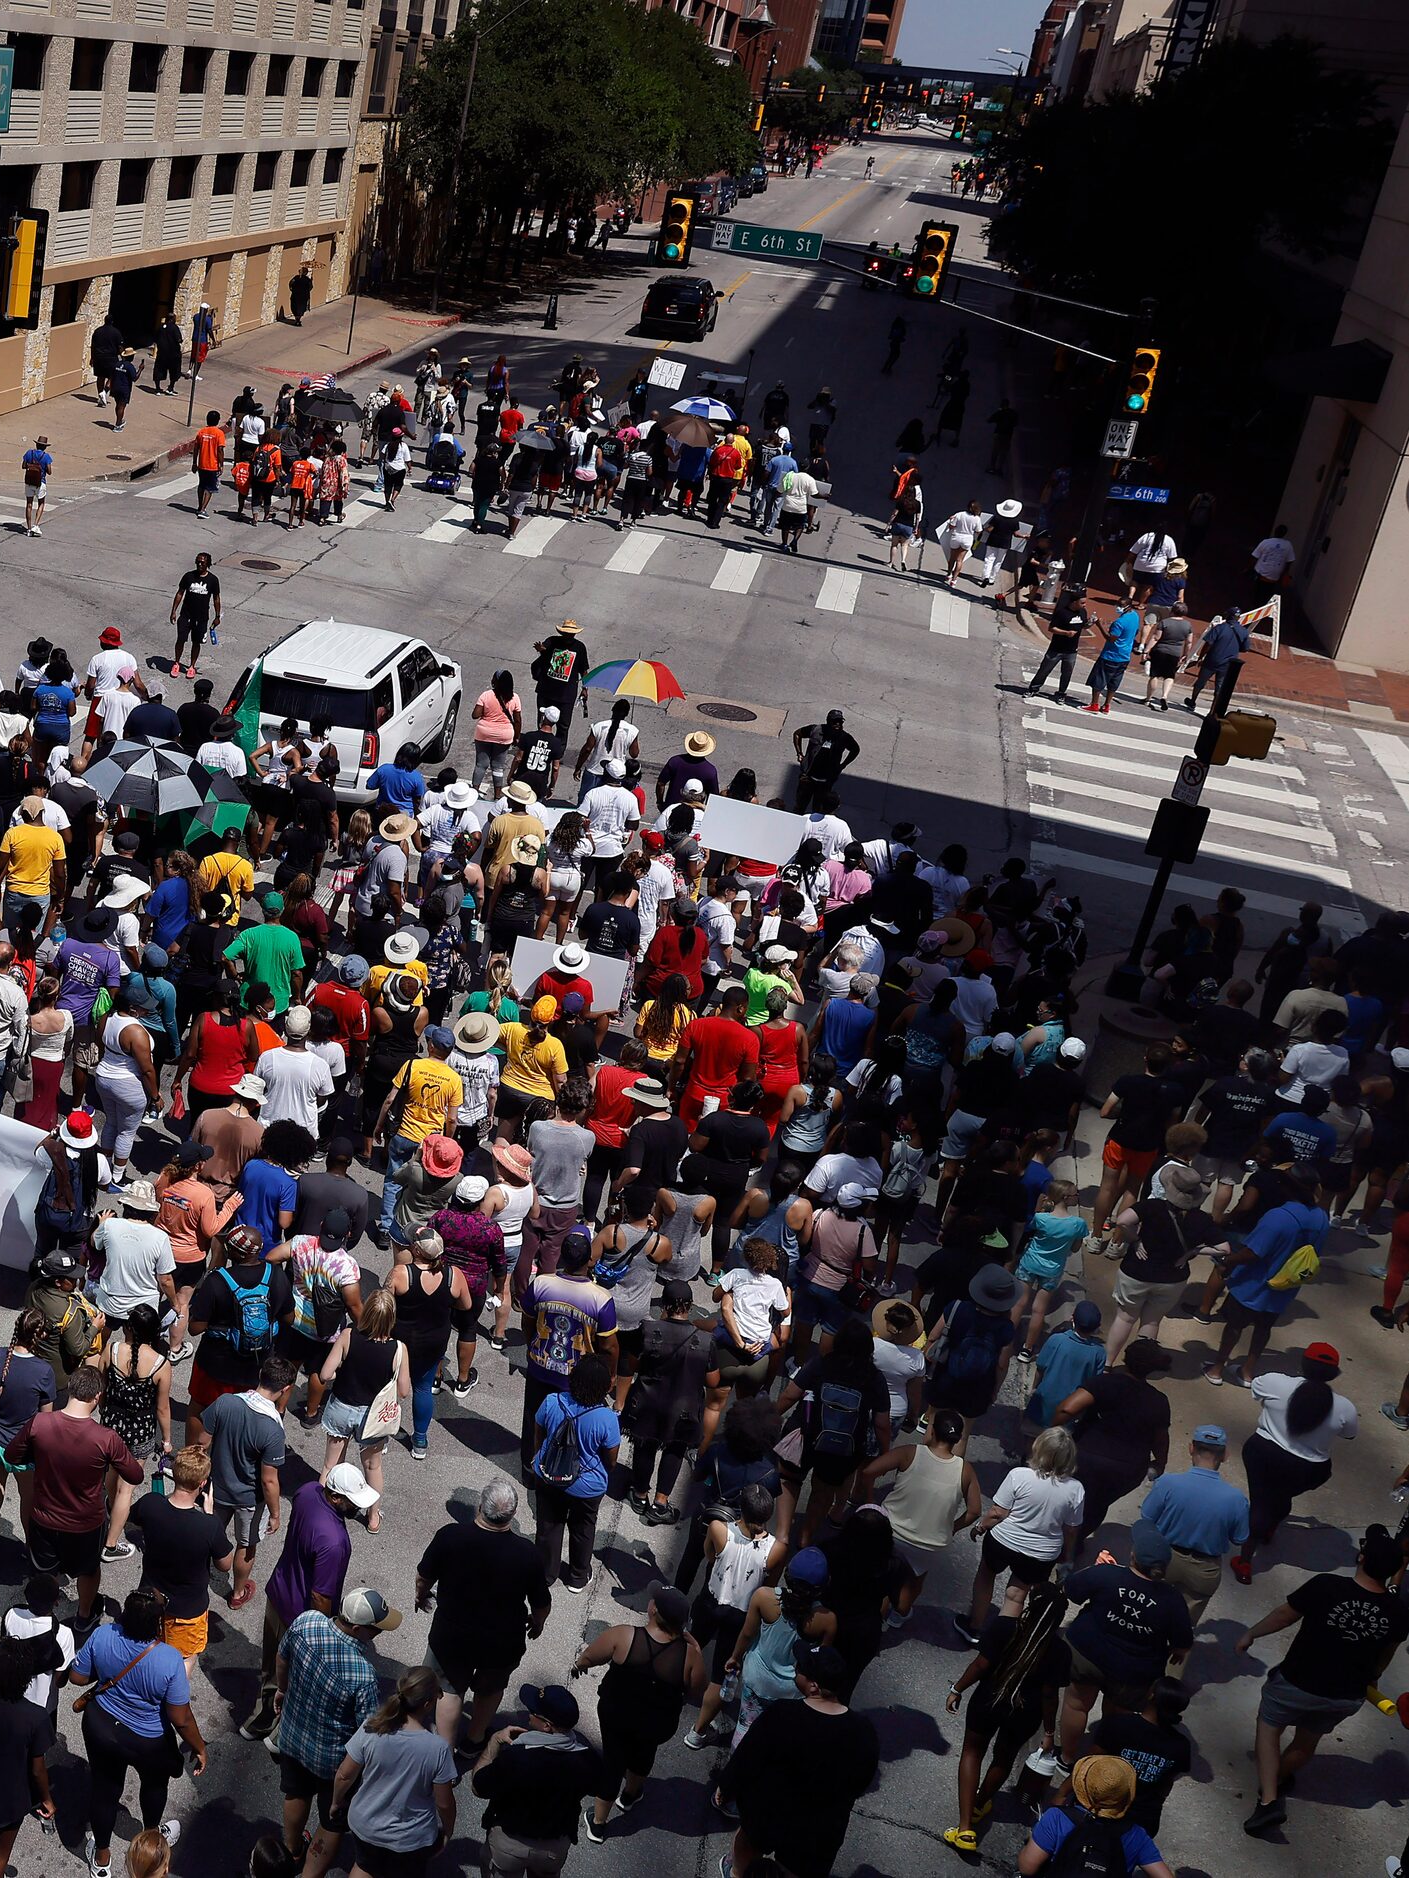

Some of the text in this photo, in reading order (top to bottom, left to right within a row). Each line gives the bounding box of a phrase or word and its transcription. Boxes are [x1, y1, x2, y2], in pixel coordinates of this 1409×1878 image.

[715, 231, 732, 240] WAY
[716, 223, 732, 232] ONE
[740, 231, 812, 253] E 6th St
[649, 373, 679, 390] LIVE
[1110, 423, 1133, 434] ONE
[1107, 433, 1130, 443] WAY
[1123, 487, 1131, 497] E
[1135, 489, 1153, 500] 6th
[530, 745, 552, 756] ABOUT
[537, 739, 549, 749] IT'S
[526, 752, 549, 772] US
[67, 962, 97, 978] CHANGE
[69, 956, 98, 973] CREATING
[1118, 1587, 1157, 1608] FORT
[1123, 1604, 1141, 1619] TX
[1105, 1610, 1154, 1635] WORTH
[1327, 1600, 1390, 1641] PANTHER CITY
[1338, 1609, 1378, 1638] FORT WORTH
[1352, 1619, 1365, 1629] TX
[1120, 1748, 1138, 1760] GET
[1137, 1751, 1158, 1766] THAT
